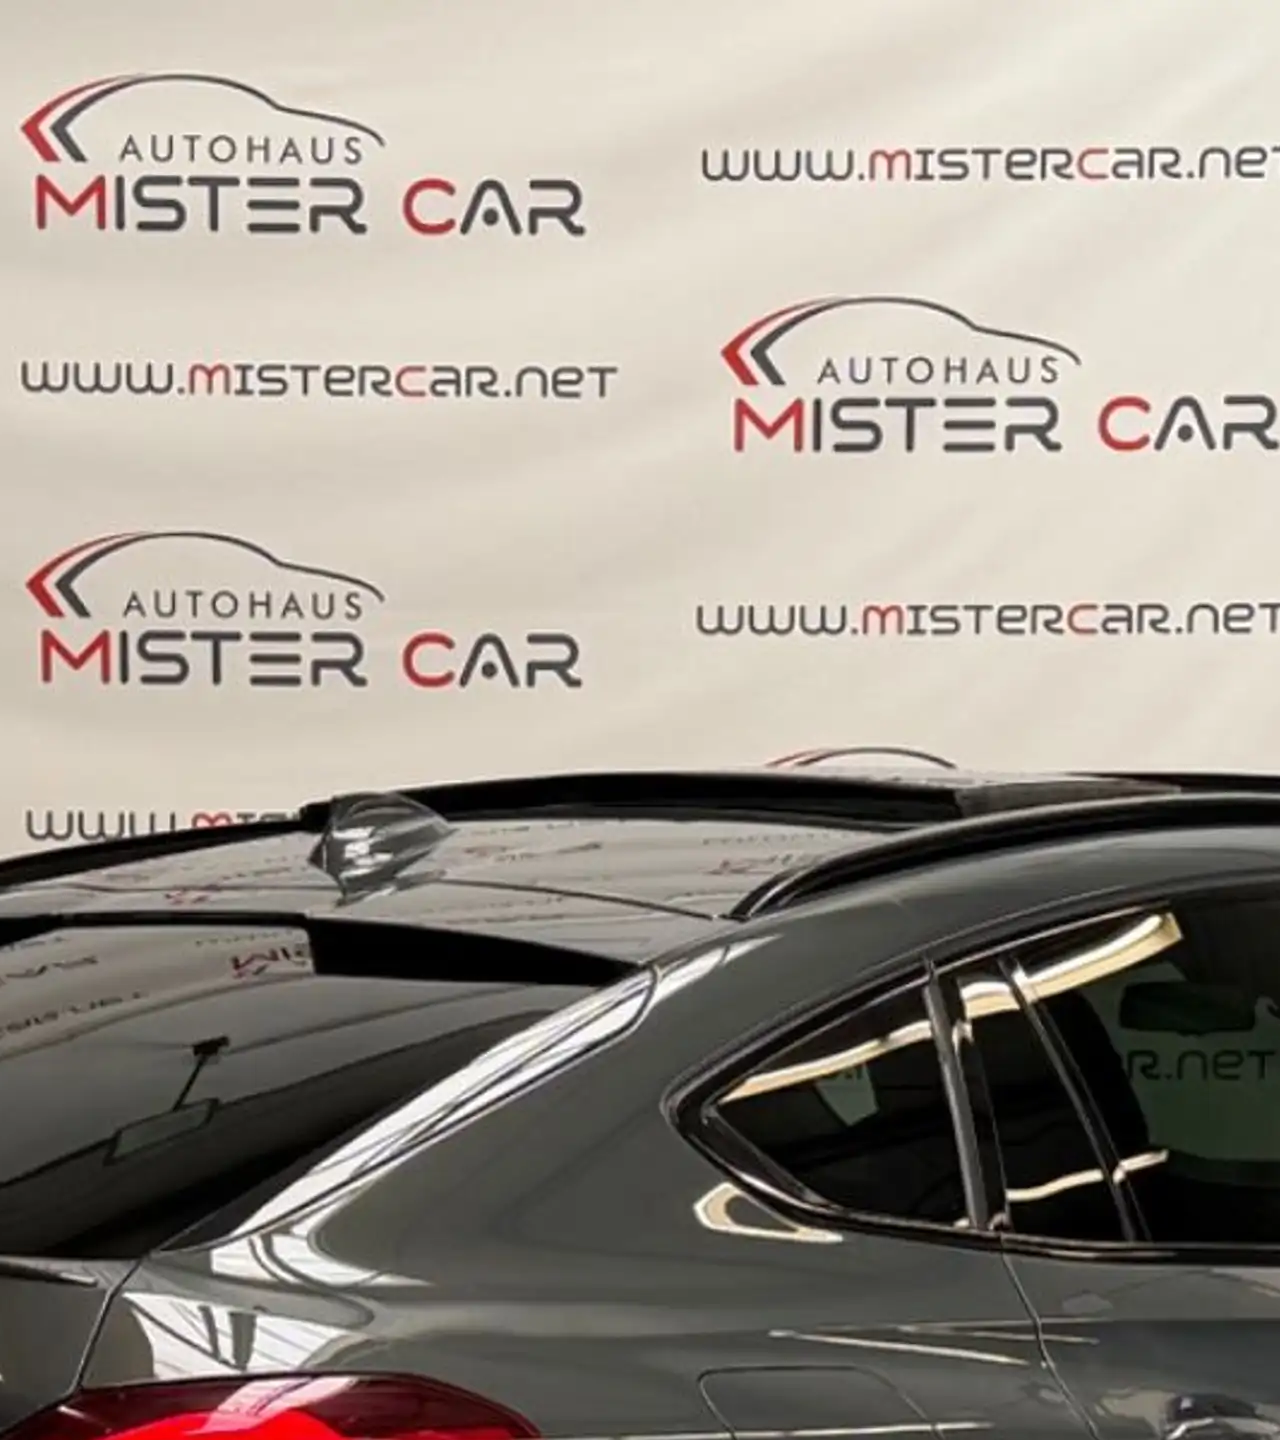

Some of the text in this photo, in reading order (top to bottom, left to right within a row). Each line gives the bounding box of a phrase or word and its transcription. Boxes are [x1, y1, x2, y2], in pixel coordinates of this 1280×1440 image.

[119, 135, 361, 165] AUTOHAUS
[36, 174, 585, 235] MISTER CAR
[817, 356, 1057, 384] AUTOHAUS
[734, 396, 1279, 452] MISTER CAR
[123, 590, 362, 620] AUTOHAUS
[41, 630, 581, 687] MISTER CAR
